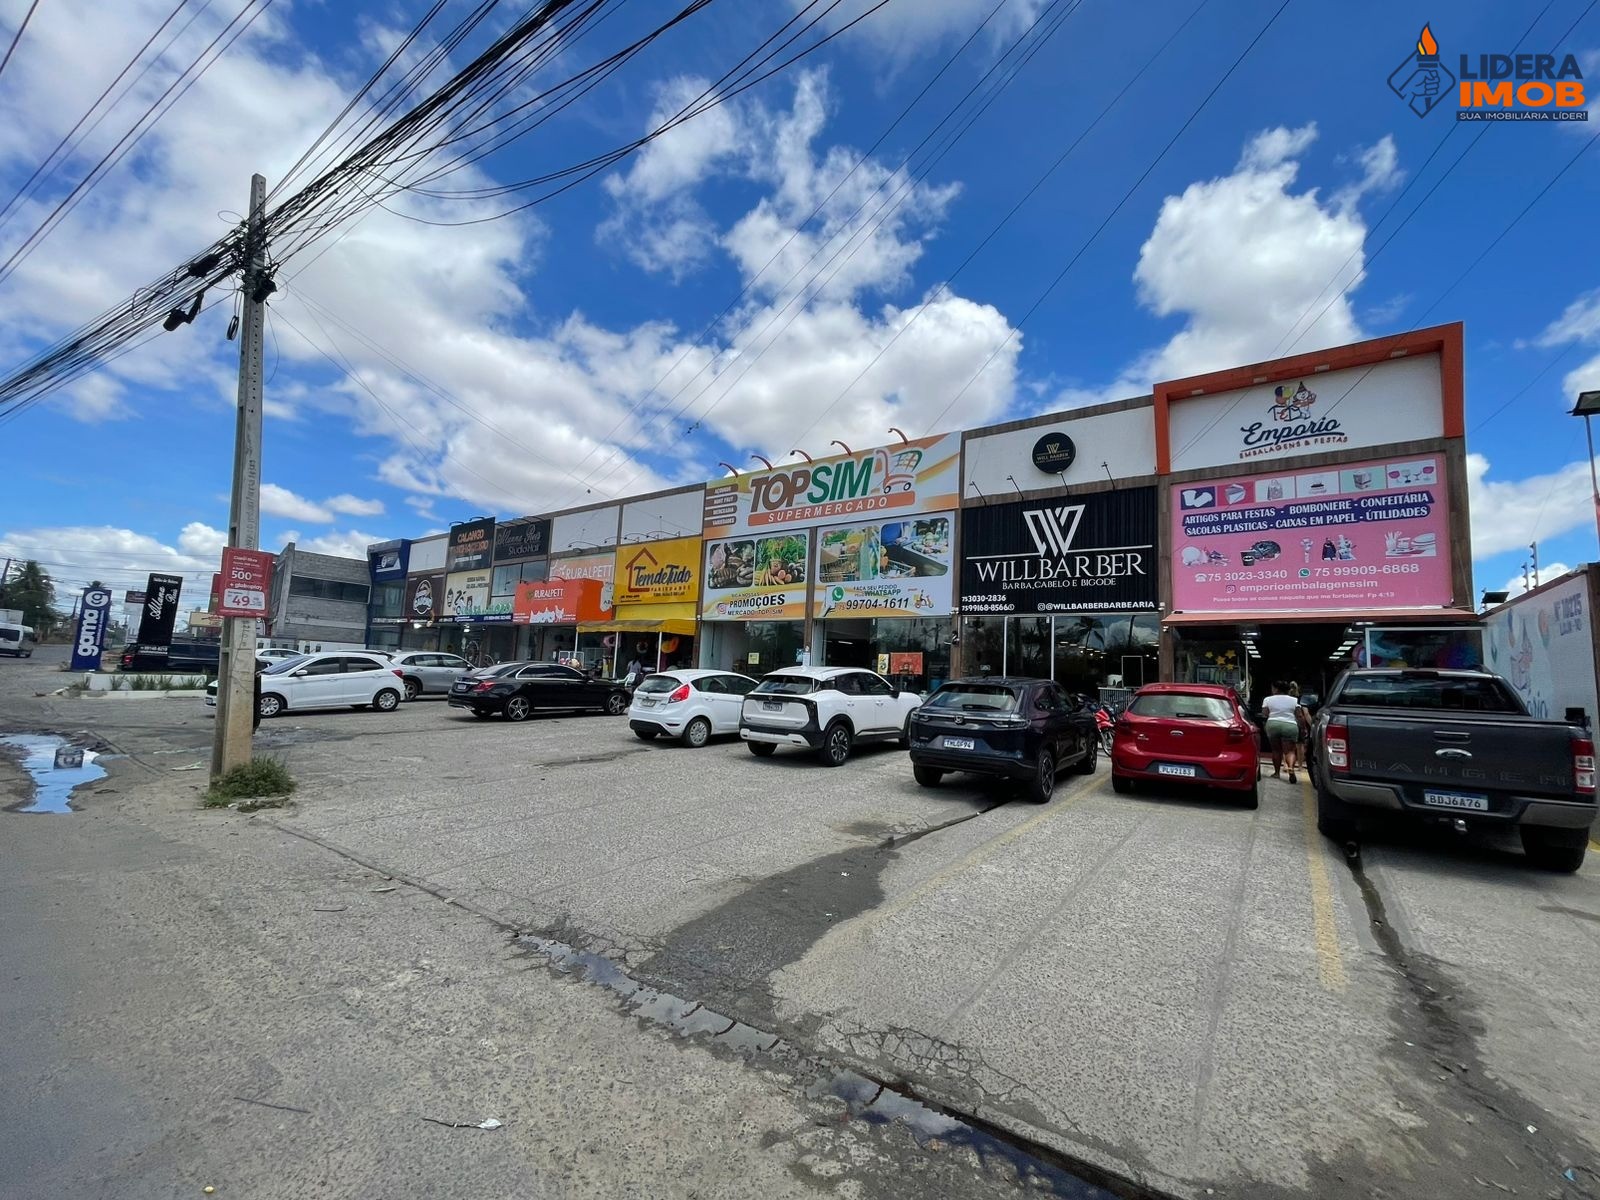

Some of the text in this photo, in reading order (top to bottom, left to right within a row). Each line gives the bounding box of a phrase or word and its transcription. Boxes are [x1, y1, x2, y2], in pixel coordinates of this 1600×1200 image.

[1239, 441, 1301, 459] EMBALAGENS
[1315, 436, 1348, 444] FESTAS
[768, 497, 888, 523] SUPERMERCADO
[1184, 513, 1219, 525] ARTIGOS
[1221, 511, 1243, 521] PARA
[1245, 508, 1276, 519] FESTAS
[1289, 500, 1353, 515] BOMBONIERE
[1360, 491, 1429, 508] CONFEITÁRIA
[1186, 524, 1222, 536] SACOLAS
[1223, 521, 1268, 533] PLASTICAS
[1275, 516, 1308, 529] CAIXAS
[1310, 516, 1323, 525] EM
[1326, 512, 1357, 523] PAPEL
[231, 570, 252, 581] 500
[1207, 563, 1420, 582] 75 3023-3340 75 99909-6868
[1081, 578, 1116, 587] BIGODE
[232, 595, 251, 607] 49
[729, 593, 785, 609] PROMOÇÕES
[864, 588, 901, 598] WHATSAPP
[845, 597, 909, 610] 99704-1611
[77, 609, 99, 657] gama
